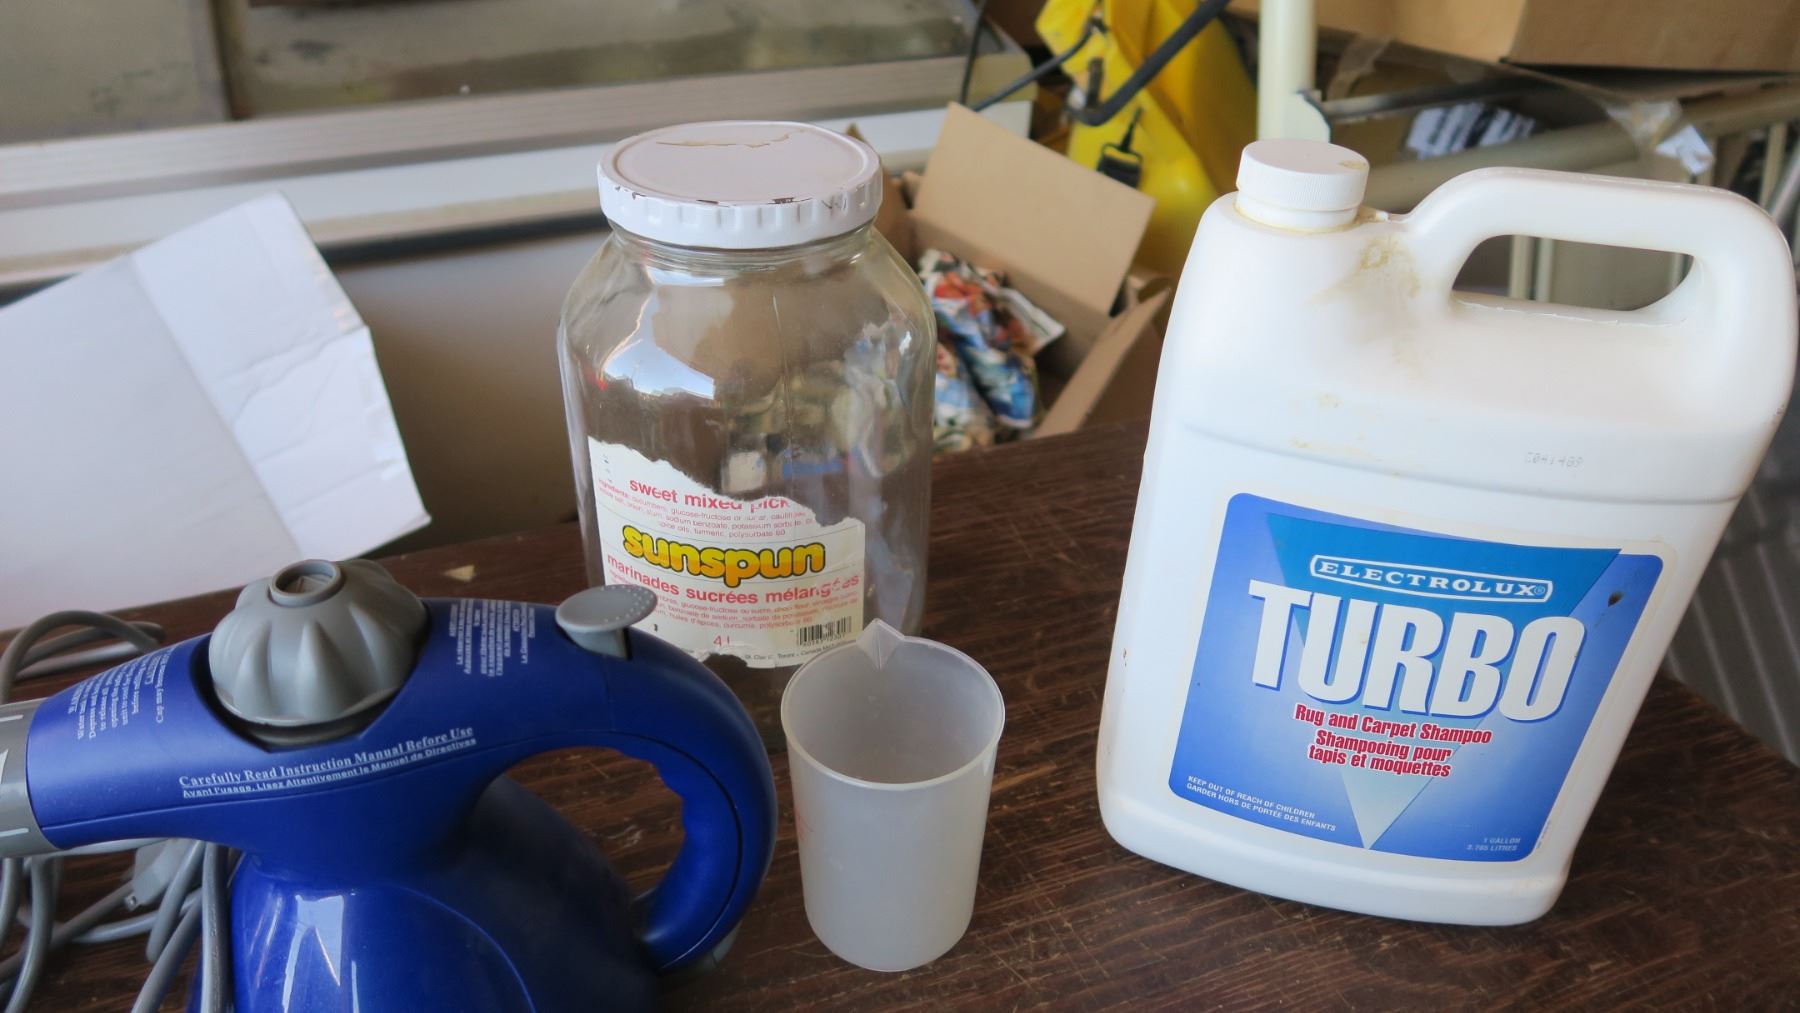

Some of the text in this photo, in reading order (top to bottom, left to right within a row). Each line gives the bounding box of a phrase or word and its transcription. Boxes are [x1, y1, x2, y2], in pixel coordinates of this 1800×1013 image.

[629, 479, 678, 503] sweet
[622, 525, 826, 588] sunspun
[1318, 561, 1536, 596] ELECTROLUX
[607, 554, 680, 596] marinades
[686, 587, 758, 604] sucrées
[713, 635, 722, 647] 4
[1248, 578, 1587, 723] TURBO
[1295, 704, 1492, 744] Rug and Carpet Shampoo
[1316, 730, 1452, 762] Shampooing pour
[178, 727, 474, 787] Carefully Read Instruction Manual Before Use
[182, 788, 213, 799] Avant
[256, 781, 284, 792] Lisez
[286, 769, 357, 788] Attentivement
[410, 752, 424, 762] de
[425, 738, 477, 757] Directives
[1308, 745, 1451, 777] tapis et moquettes
[1186, 782, 1217, 799] GARDER
[1218, 793, 1239, 806] HORS
[1241, 801, 1252, 809] DE
[1284, 813, 1299, 823] DES
[1301, 817, 1337, 832] ENFANTS
[1188, 775, 1316, 819] KEEP OUT OF REACH OF CHILDREN
